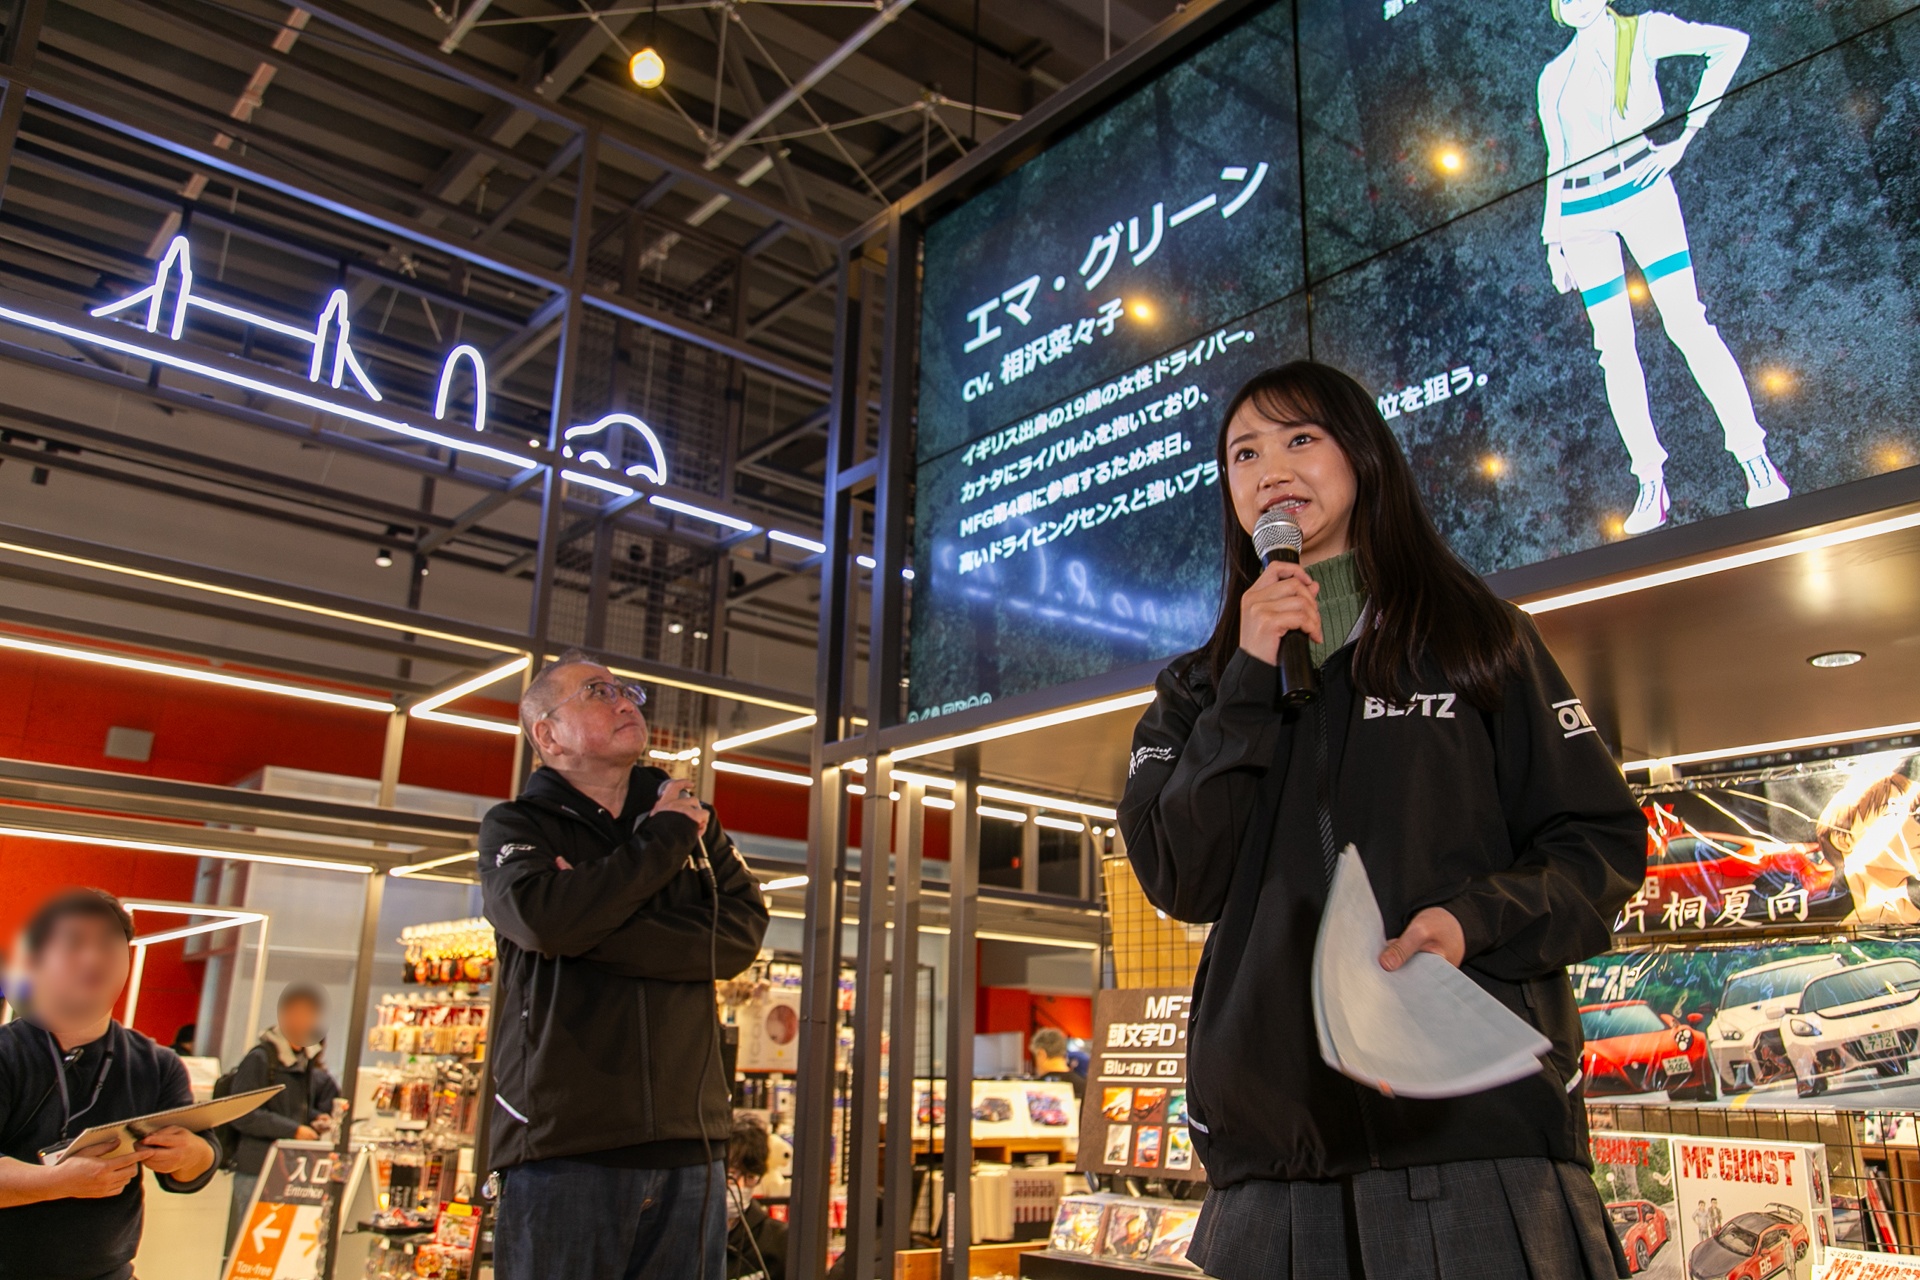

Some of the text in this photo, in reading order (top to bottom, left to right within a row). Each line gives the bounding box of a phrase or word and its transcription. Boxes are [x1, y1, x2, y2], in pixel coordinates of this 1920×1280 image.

[963, 161, 1269, 353] エマ・グリーン
[1000, 297, 1124, 386] 相沢菜々子
[959, 384, 1210, 504] カナタにライバル心を抱いており、
[1620, 882, 1810, 935] 片桐夏向
[1103, 1059, 1178, 1077] Blu-ray CD
[286, 1156, 333, 1184] 入口
[1718, 1147, 1796, 1187] GHOST
[235, 1260, 273, 1277] Tax-free
[1759, 1256, 1773, 1275] 86
